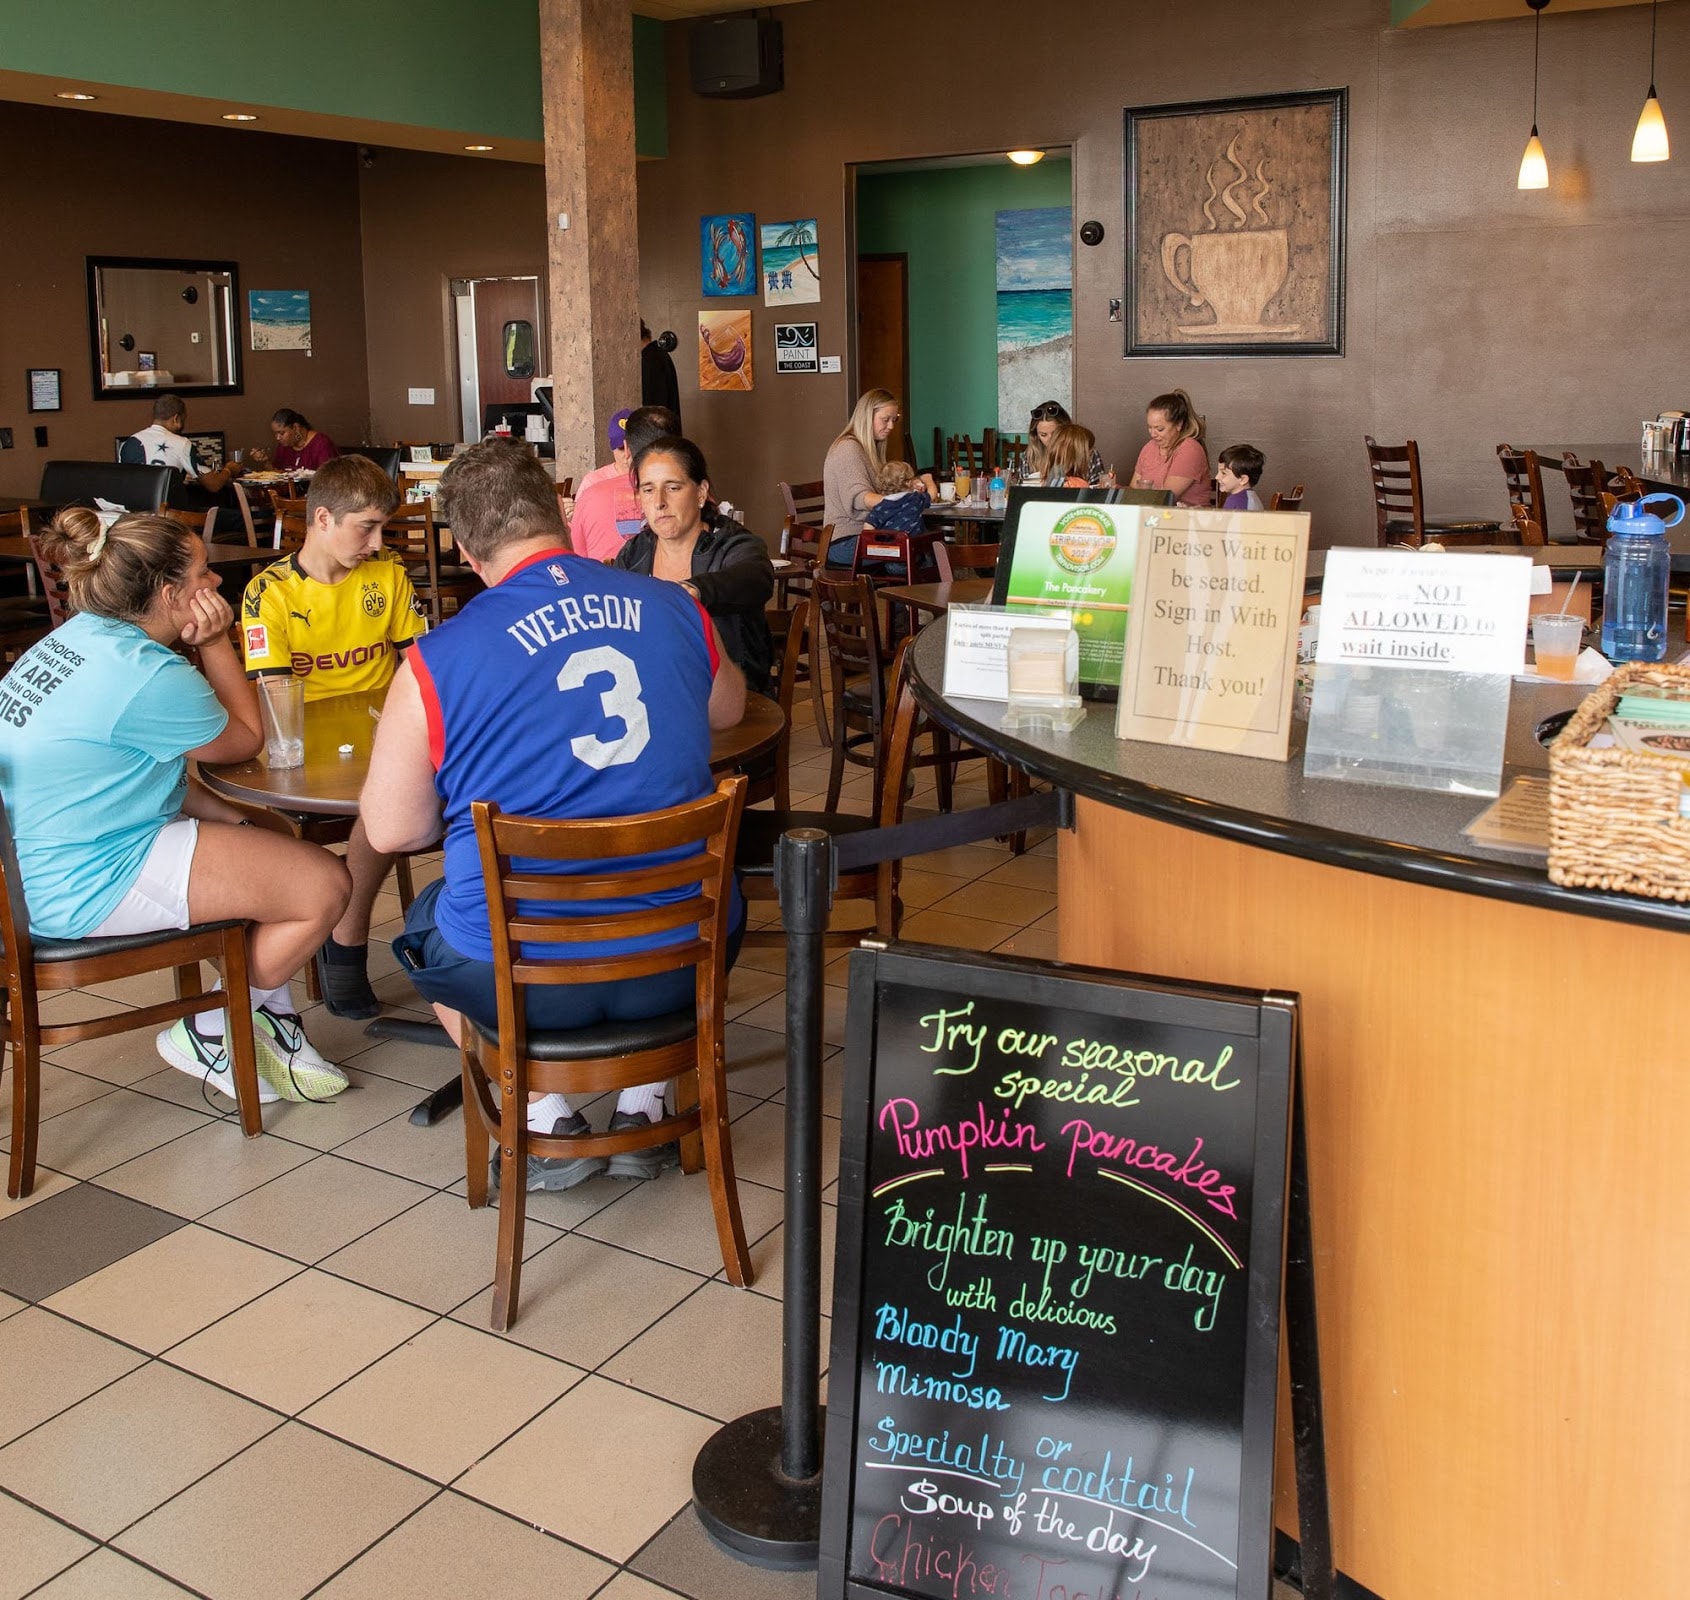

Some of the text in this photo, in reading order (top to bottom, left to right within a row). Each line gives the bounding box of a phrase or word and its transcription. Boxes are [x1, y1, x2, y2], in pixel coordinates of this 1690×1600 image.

[783, 349, 810, 360] PAINT
[1153, 535, 1293, 563] Please Wait to
[1045, 581, 1107, 598] The Pancakery
[1171, 568, 1265, 594] be seated.
[1416, 584, 1464, 602] NOT
[366, 592, 385, 611] BVB
[1154, 599, 1278, 628] Sign in With
[507, 594, 642, 656] IVERSON
[1344, 610, 1469, 631] ALLOWED
[44, 637, 85, 667] CHOICES
[316, 638, 392, 670] EVONI
[1186, 634, 1236, 658] Host.
[1342, 638, 1455, 659] wait inside.
[36, 649, 74, 678] WHAT WE
[21, 665, 63, 695] ARE
[1153, 665, 1265, 698] Thank you!
[0, 690, 33, 728] TIES
[22, 689, 43, 706] OUR
[556, 645, 651, 770] 3
[920, 1001, 1241, 1091] Try our seasonal
[994, 1069, 1140, 1109] special
[879, 1097, 1046, 1179] Pumpkin
[885, 1191, 1226, 1331] Brighten up your day
[946, 1276, 1117, 1335] with delicious
[875, 1302, 1080, 1401] Bloody Mary
[875, 1360, 1011, 1411] Mimosa
[1035, 1436, 1073, 1460] or
[869, 1415, 1198, 1528] Specialty cocktail
[900, 1477, 995, 1531] Soup
[1003, 1491, 1029, 1535] of
[1034, 1497, 1083, 1541] the
[1086, 1509, 1158, 1582] day
[871, 1514, 1011, 1599] Chicken
